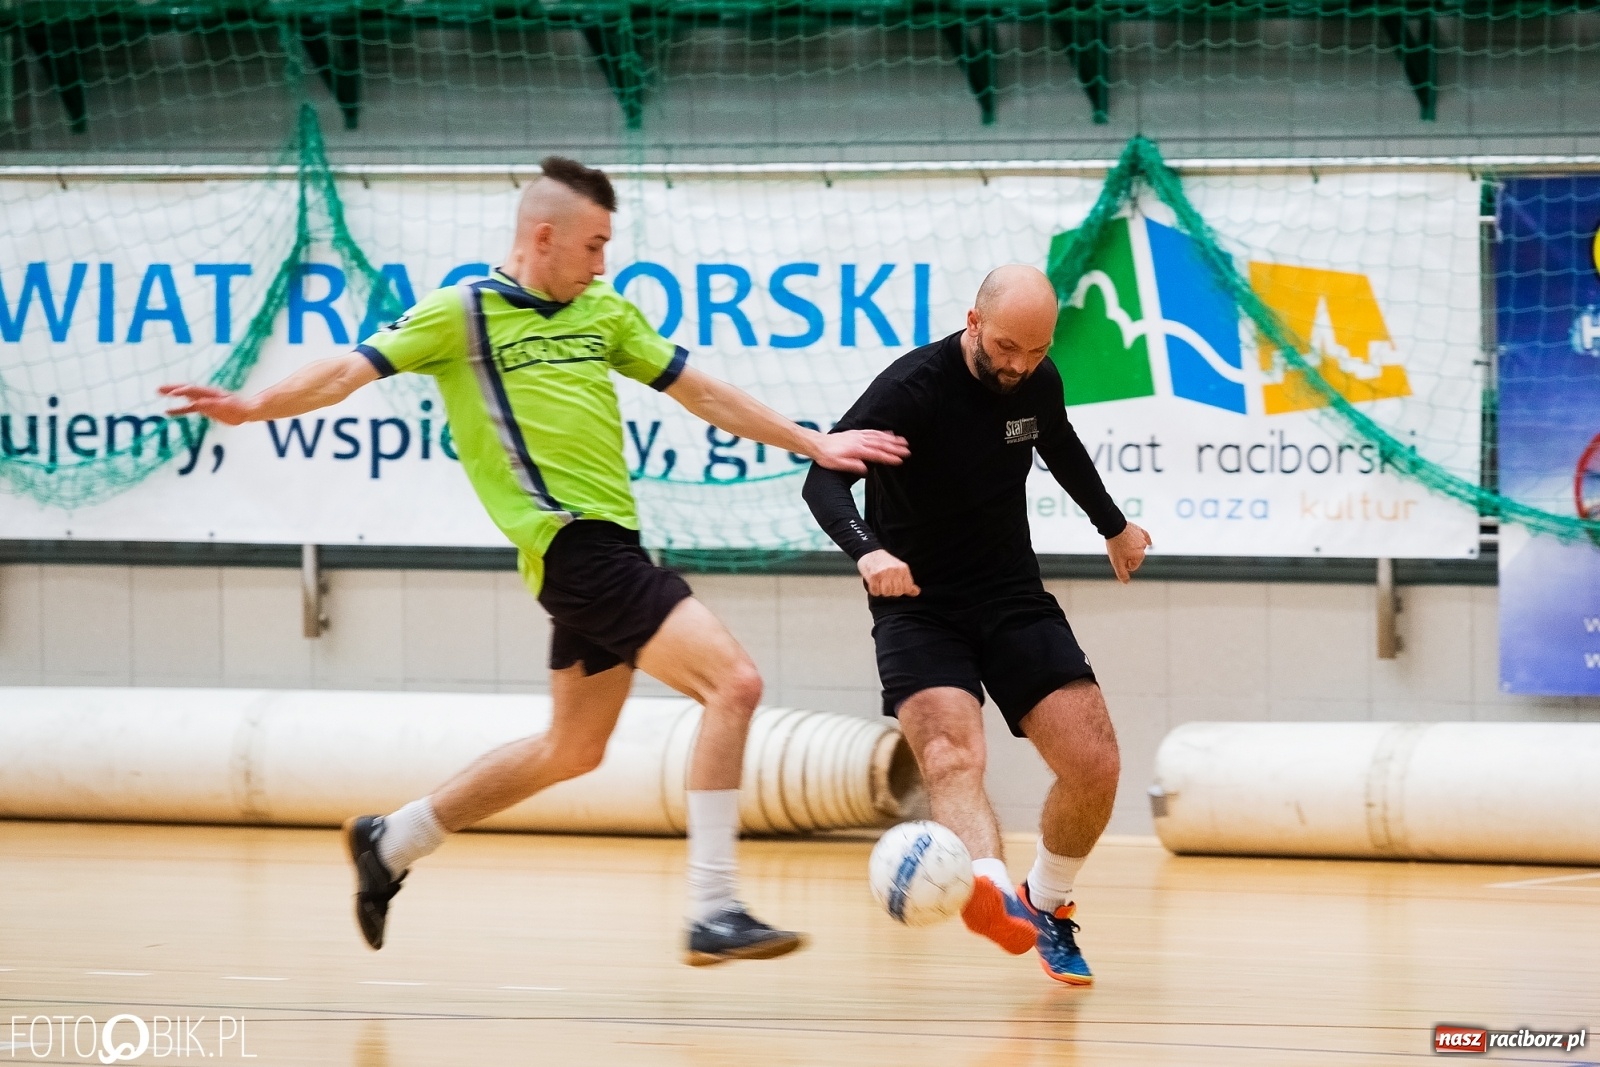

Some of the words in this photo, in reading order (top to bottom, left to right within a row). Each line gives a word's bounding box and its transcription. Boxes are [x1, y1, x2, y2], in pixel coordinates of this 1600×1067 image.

[288, 262, 930, 348] RAORSKI
[1176, 497, 1269, 520] oaza
[1300, 491, 1417, 521] kultur
